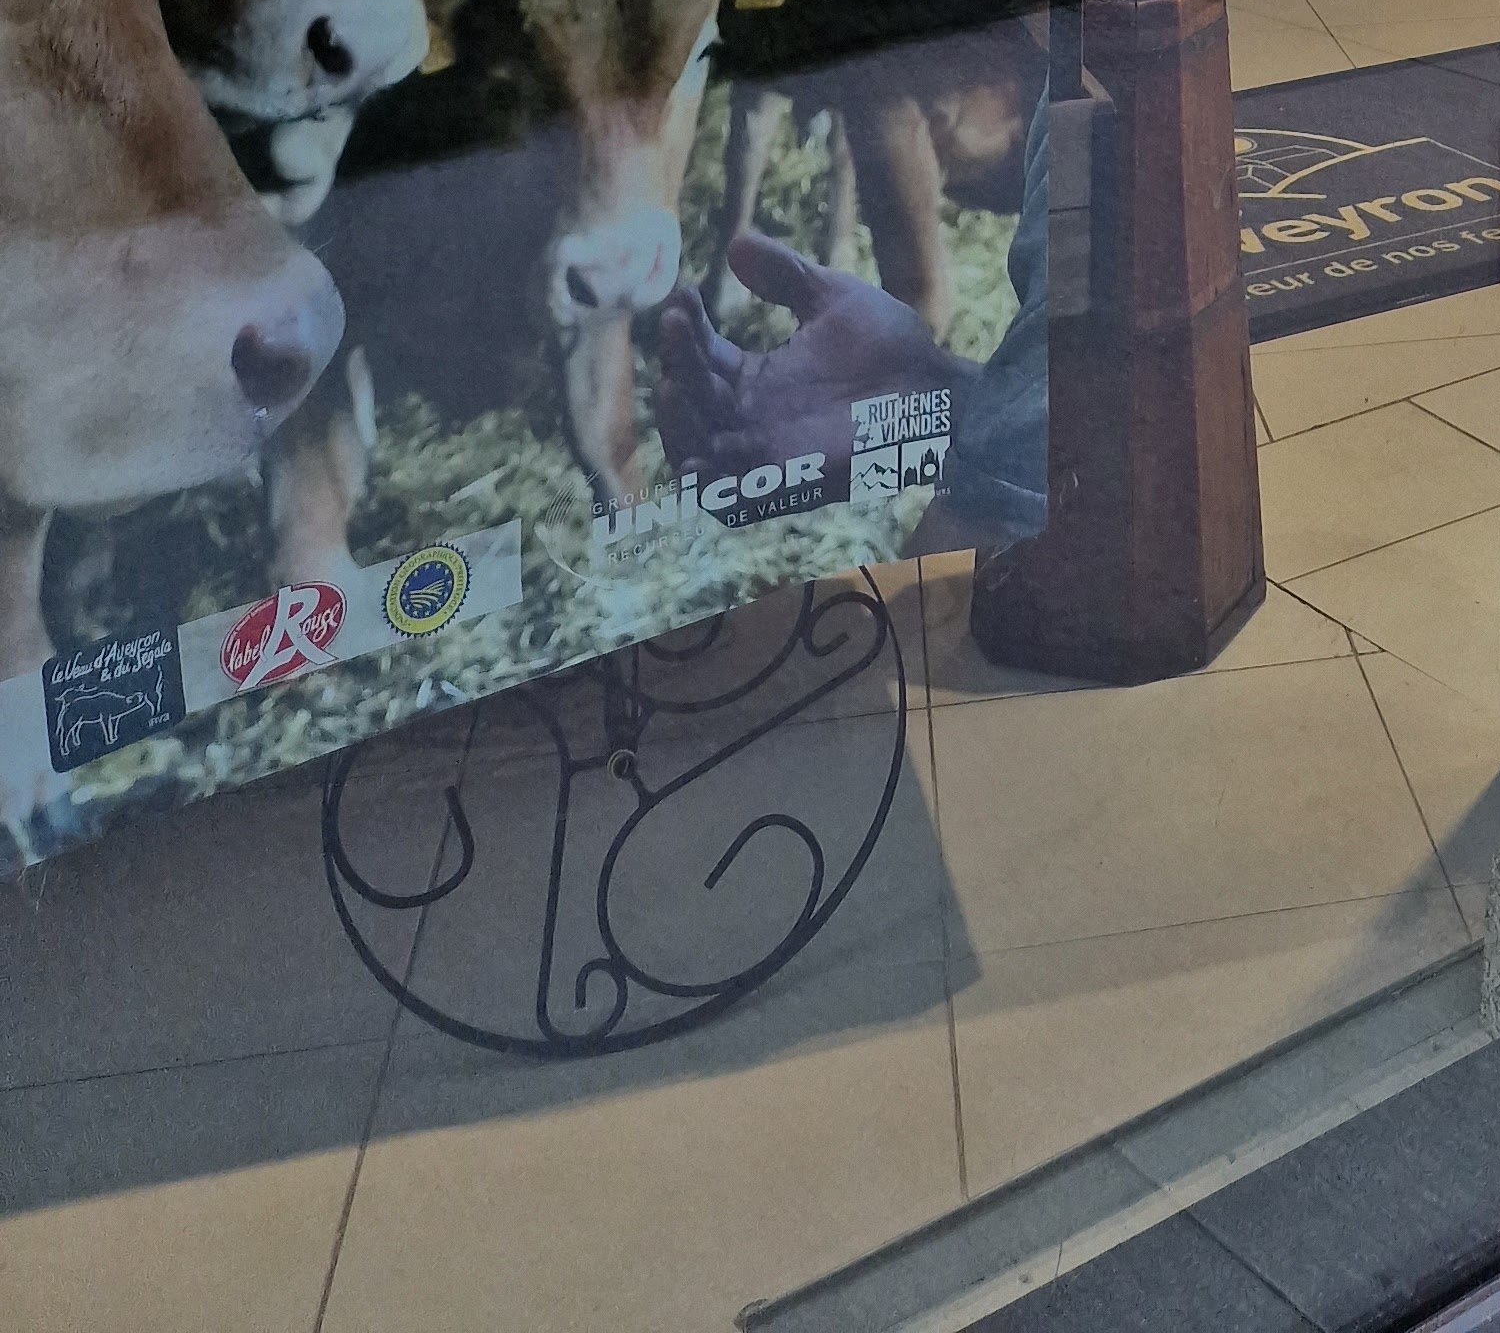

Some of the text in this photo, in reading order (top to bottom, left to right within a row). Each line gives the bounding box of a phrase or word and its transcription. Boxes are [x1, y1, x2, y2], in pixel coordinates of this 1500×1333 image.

[1325, 256, 1378, 280] de
[1382, 237, 1460, 264] nos
[869, 389, 951, 423] RUTHÈNES
[881, 410, 951, 443] VIANDES
[593, 478, 677, 515] GROUPE
[727, 487, 823, 527] DE VALEUR
[228, 624, 271, 673] label
[114, 660, 131, 678] du
